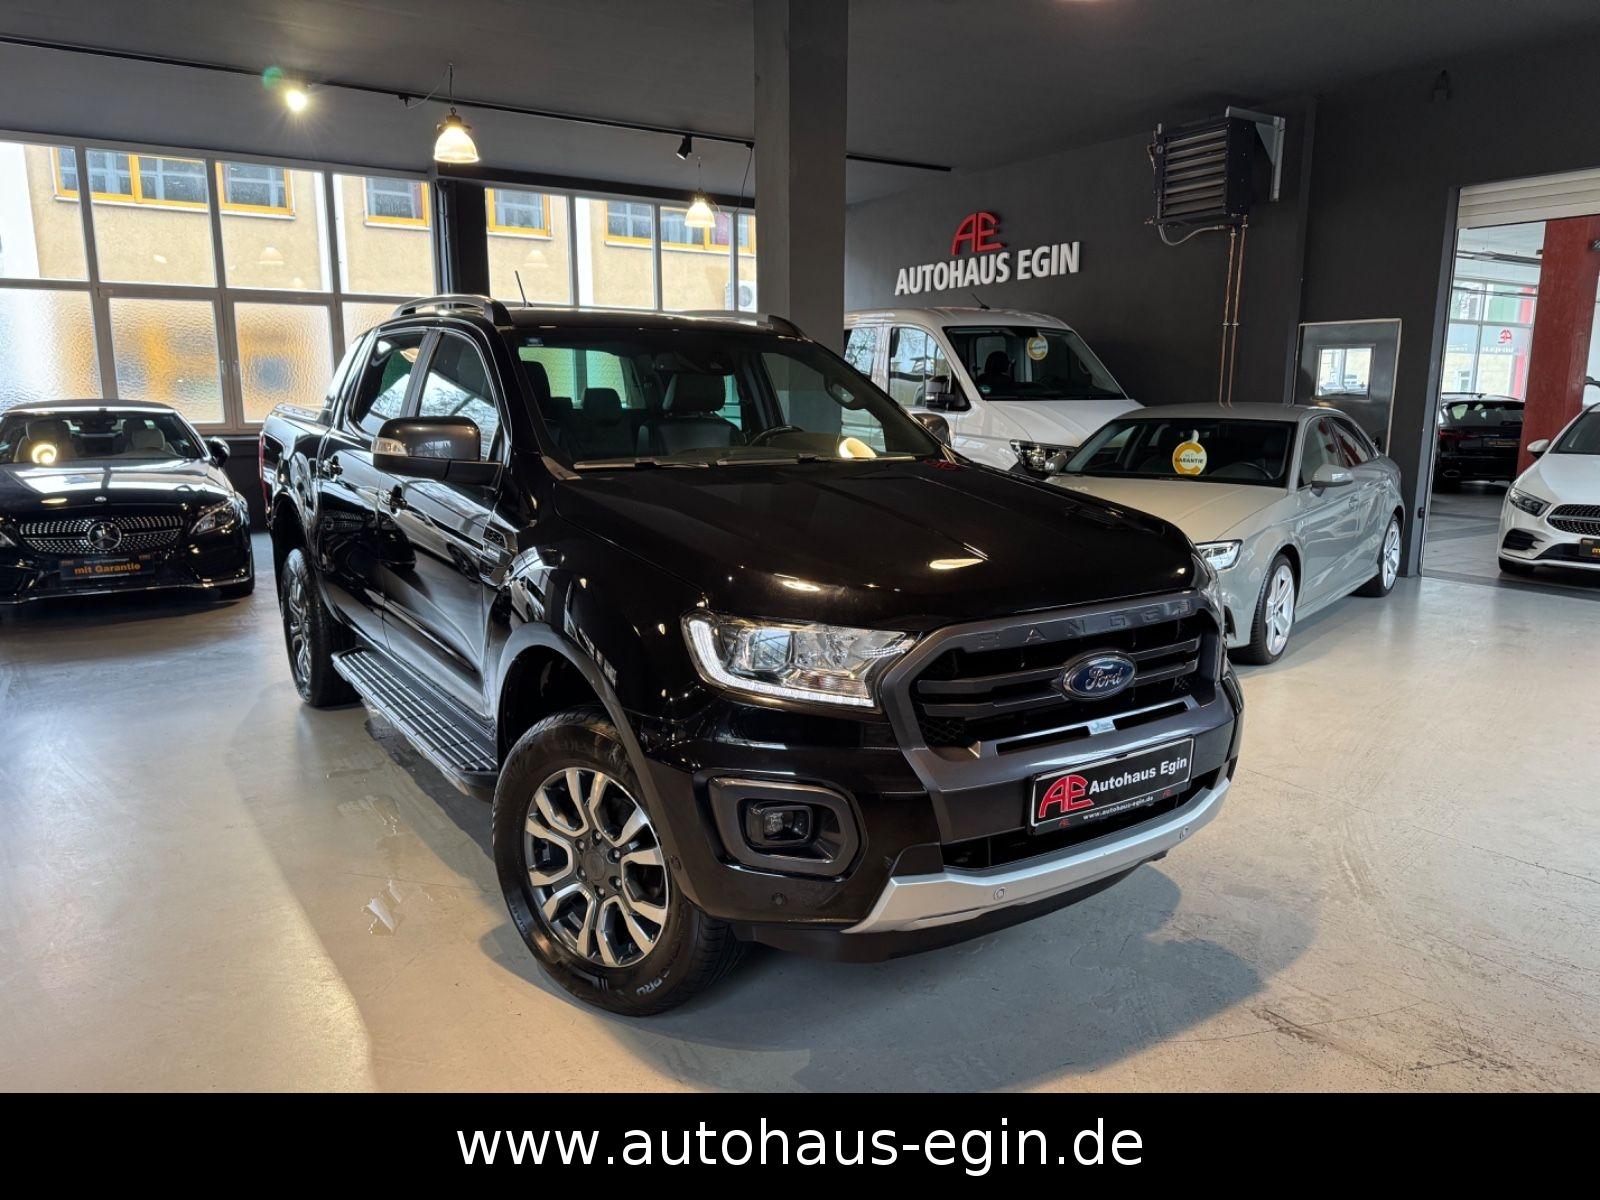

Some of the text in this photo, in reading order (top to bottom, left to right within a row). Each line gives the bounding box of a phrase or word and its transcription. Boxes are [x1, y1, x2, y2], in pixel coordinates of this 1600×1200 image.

[951, 211, 1006, 256] AE
[894, 241, 1080, 296] AUTOHAUS EGIN
[74, 562, 141, 575] mit Garantie
[1084, 667, 1123, 691] Ford
[1089, 756, 1188, 795] Autohaus Egin
[1038, 774, 1095, 819] AE
[1083, 795, 1154, 820] www.autohaus-egin.de
